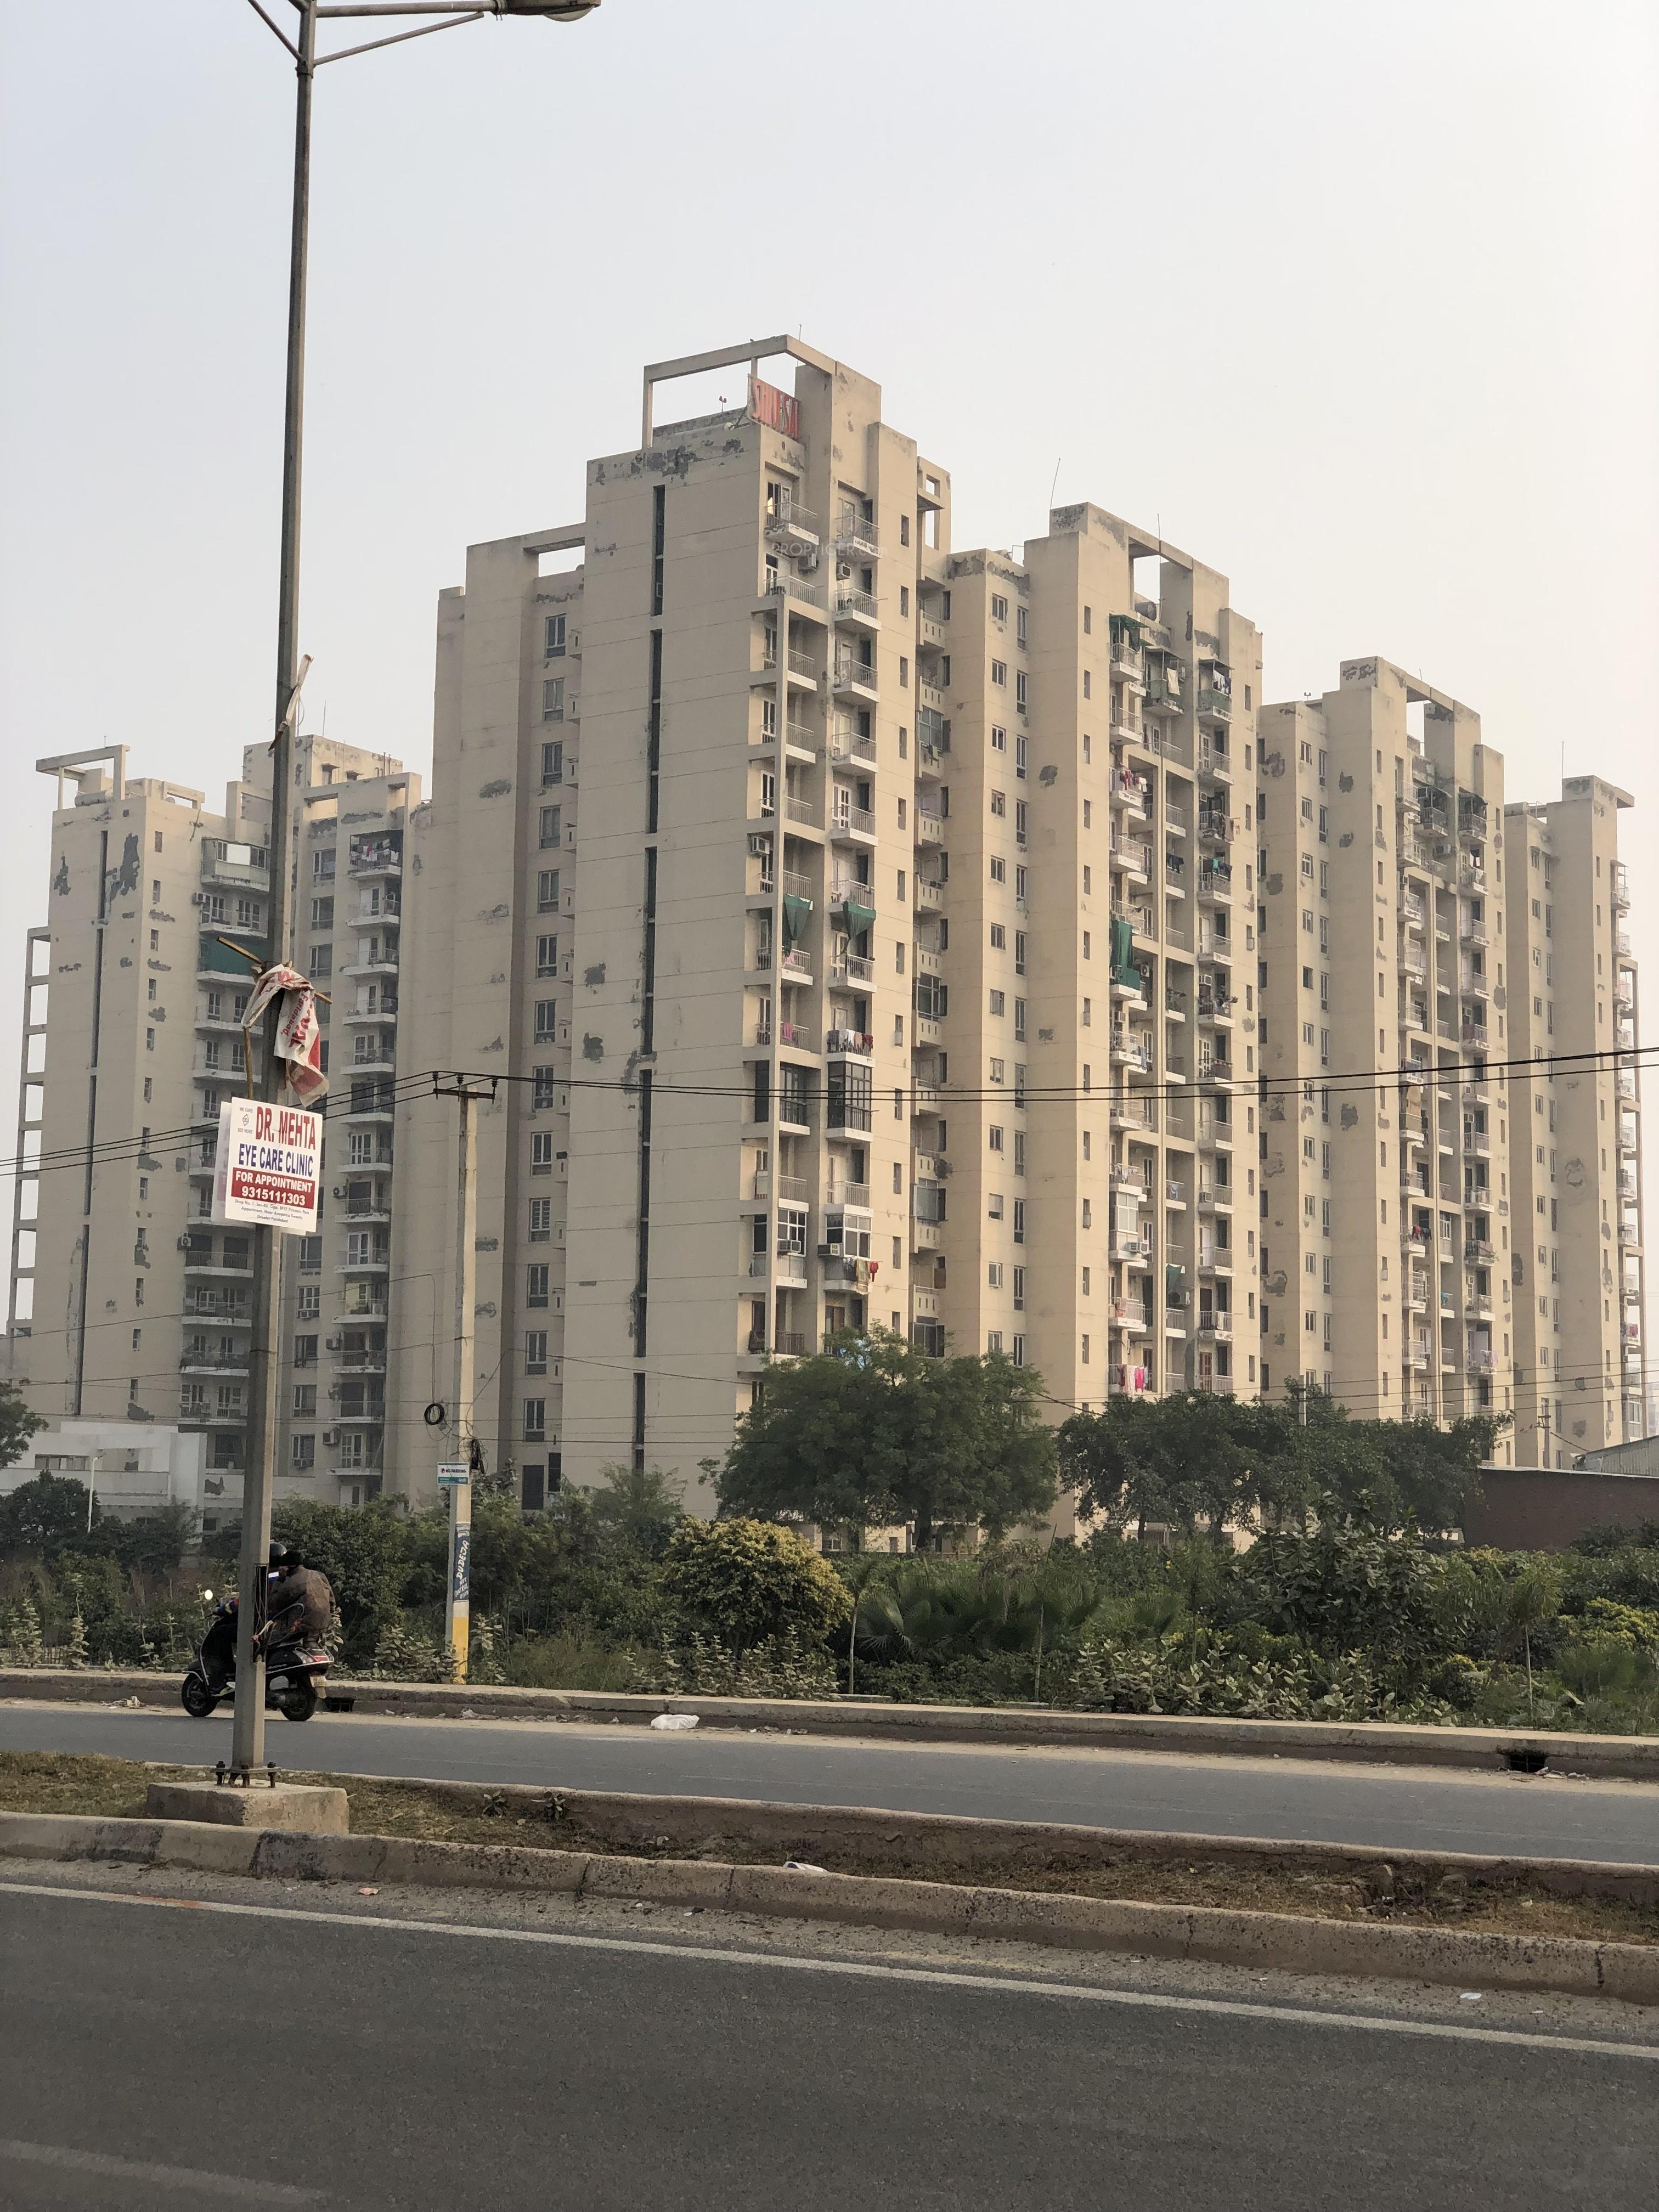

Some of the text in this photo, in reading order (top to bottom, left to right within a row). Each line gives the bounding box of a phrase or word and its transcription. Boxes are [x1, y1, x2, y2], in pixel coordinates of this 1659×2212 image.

[256, 1106, 315, 1150] DR. MEHTA
[239, 1143, 257, 1167] EYE
[259, 1147, 283, 1171] CARE
[286, 1151, 313, 1177] CLINIC
[235, 1170, 312, 1193] FOR APPOINTMENT
[241, 1186, 306, 1206] 9315111303
[456, 1539, 470, 1581] DUDEJA
